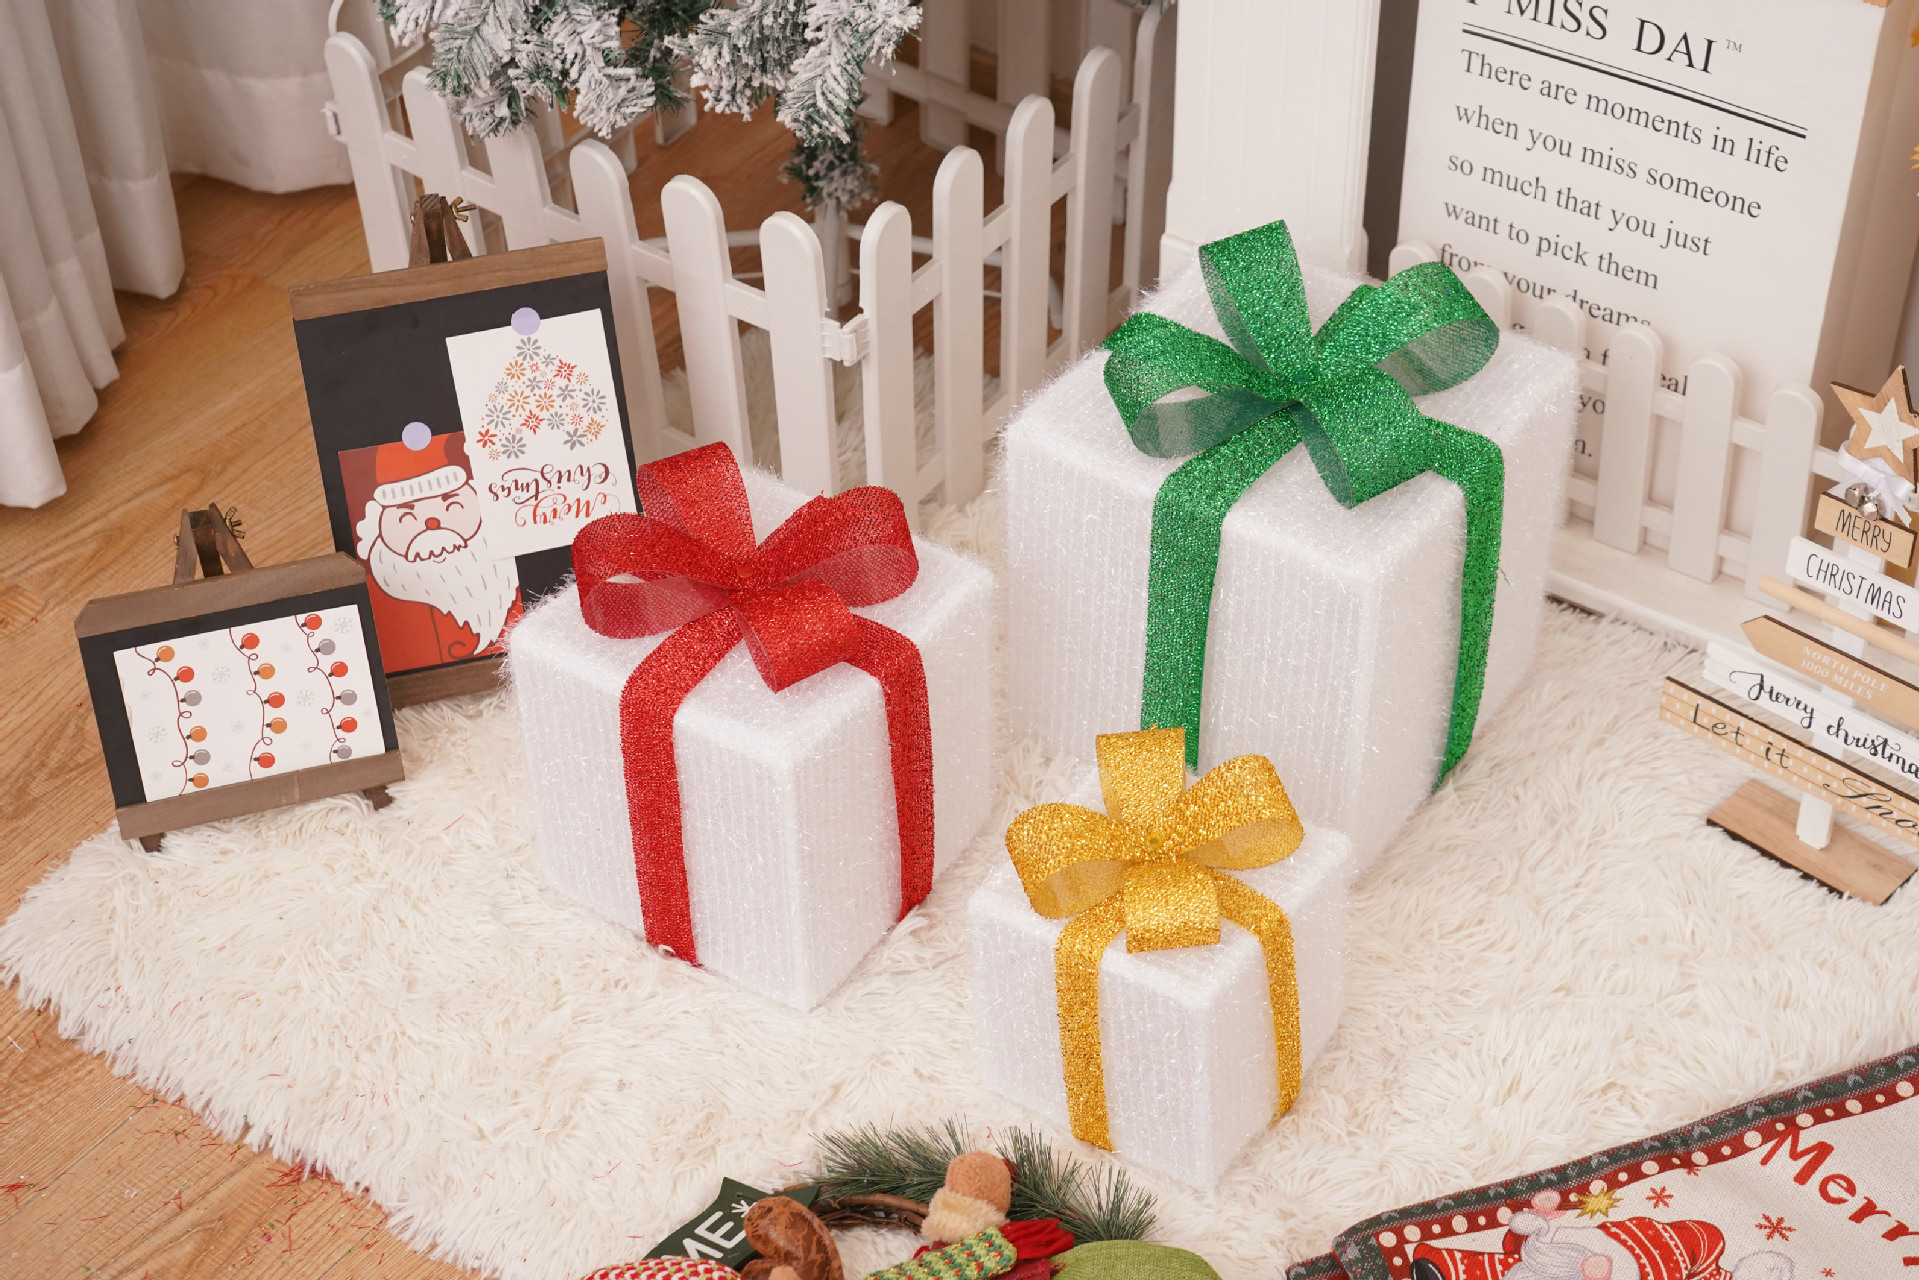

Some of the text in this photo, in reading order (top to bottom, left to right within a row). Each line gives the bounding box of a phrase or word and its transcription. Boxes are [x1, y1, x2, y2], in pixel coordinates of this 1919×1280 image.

[1504, 0, 1609, 41] MISS
[1632, 17, 1718, 74] DAI
[1461, 48, 1789, 172] There are moments in life
[1455, 104, 1762, 219] when you miss someone
[1448, 155, 1712, 257] so much that you just
[1440, 242, 1493, 272] fro
[1444, 201, 1659, 291] want to pick them
[487, 462, 618, 506] Christmas
[514, 491, 621, 528] Merry
[1834, 508, 1893, 553] MERRY
[1805, 553, 1907, 620] CHRISTMAS
[1729, 670, 1815, 729] Merry
[1800, 658, 1874, 700] 1000 MILES
[1803, 645, 1890, 694] NORTH POLE
[1692, 702, 1919, 836] Let it Sno
[1759, 1126, 1919, 1267] Merr
